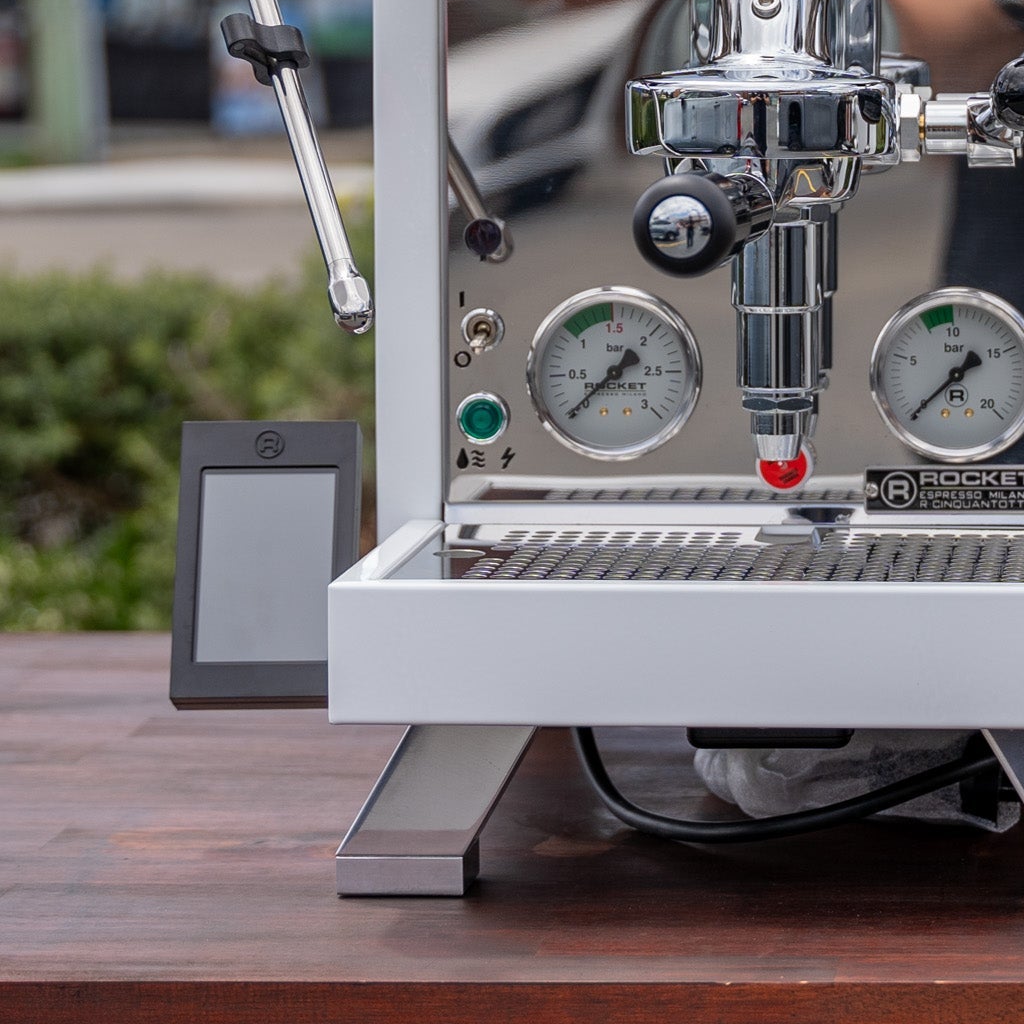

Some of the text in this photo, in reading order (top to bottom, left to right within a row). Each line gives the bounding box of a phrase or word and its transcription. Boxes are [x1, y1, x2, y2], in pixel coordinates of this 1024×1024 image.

[605, 323, 623, 333] 1.5
[946, 327, 960, 337] 10
[640, 337, 647, 347] 2
[606, 344, 624, 352] bar
[944, 343, 964, 353] bar
[987, 348, 1001, 358] 15
[910, 356, 917, 366] 5
[569, 369, 587, 379] 0.5
[644, 366, 662, 376] 2.5
[949, 389, 965, 402] R
[641, 399, 648, 409] 3
[980, 399, 995, 409] 20
[888, 480, 910, 500] R
[919, 491, 982, 500] ESPRESSO
[919, 500, 928, 509] R
